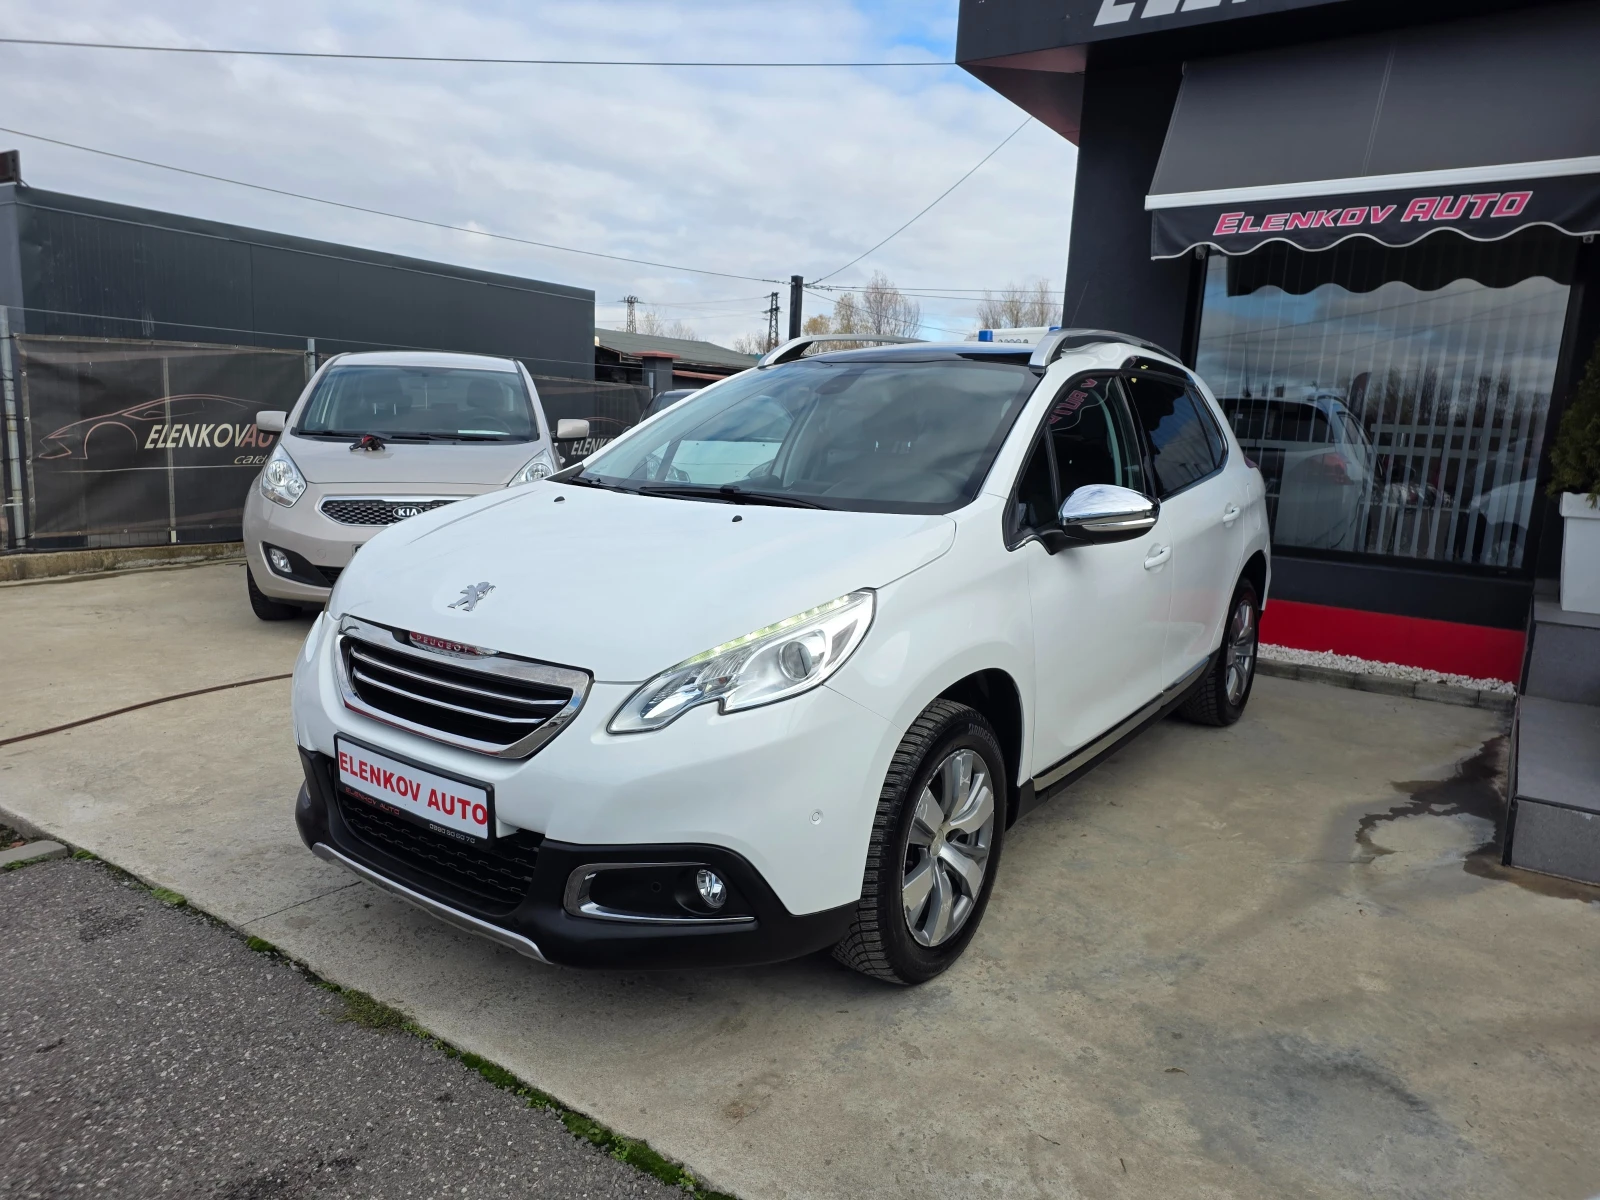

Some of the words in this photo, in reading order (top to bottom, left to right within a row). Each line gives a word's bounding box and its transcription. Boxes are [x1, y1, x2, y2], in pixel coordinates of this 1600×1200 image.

[1213, 205, 1397, 236] ELENKOV
[1400, 191, 1533, 223] AUTO
[397, 508, 418, 517] KIA
[416, 634, 470, 653] PEUGEOT
[339, 751, 421, 802] ELENKOV
[427, 788, 488, 825] AUTO
